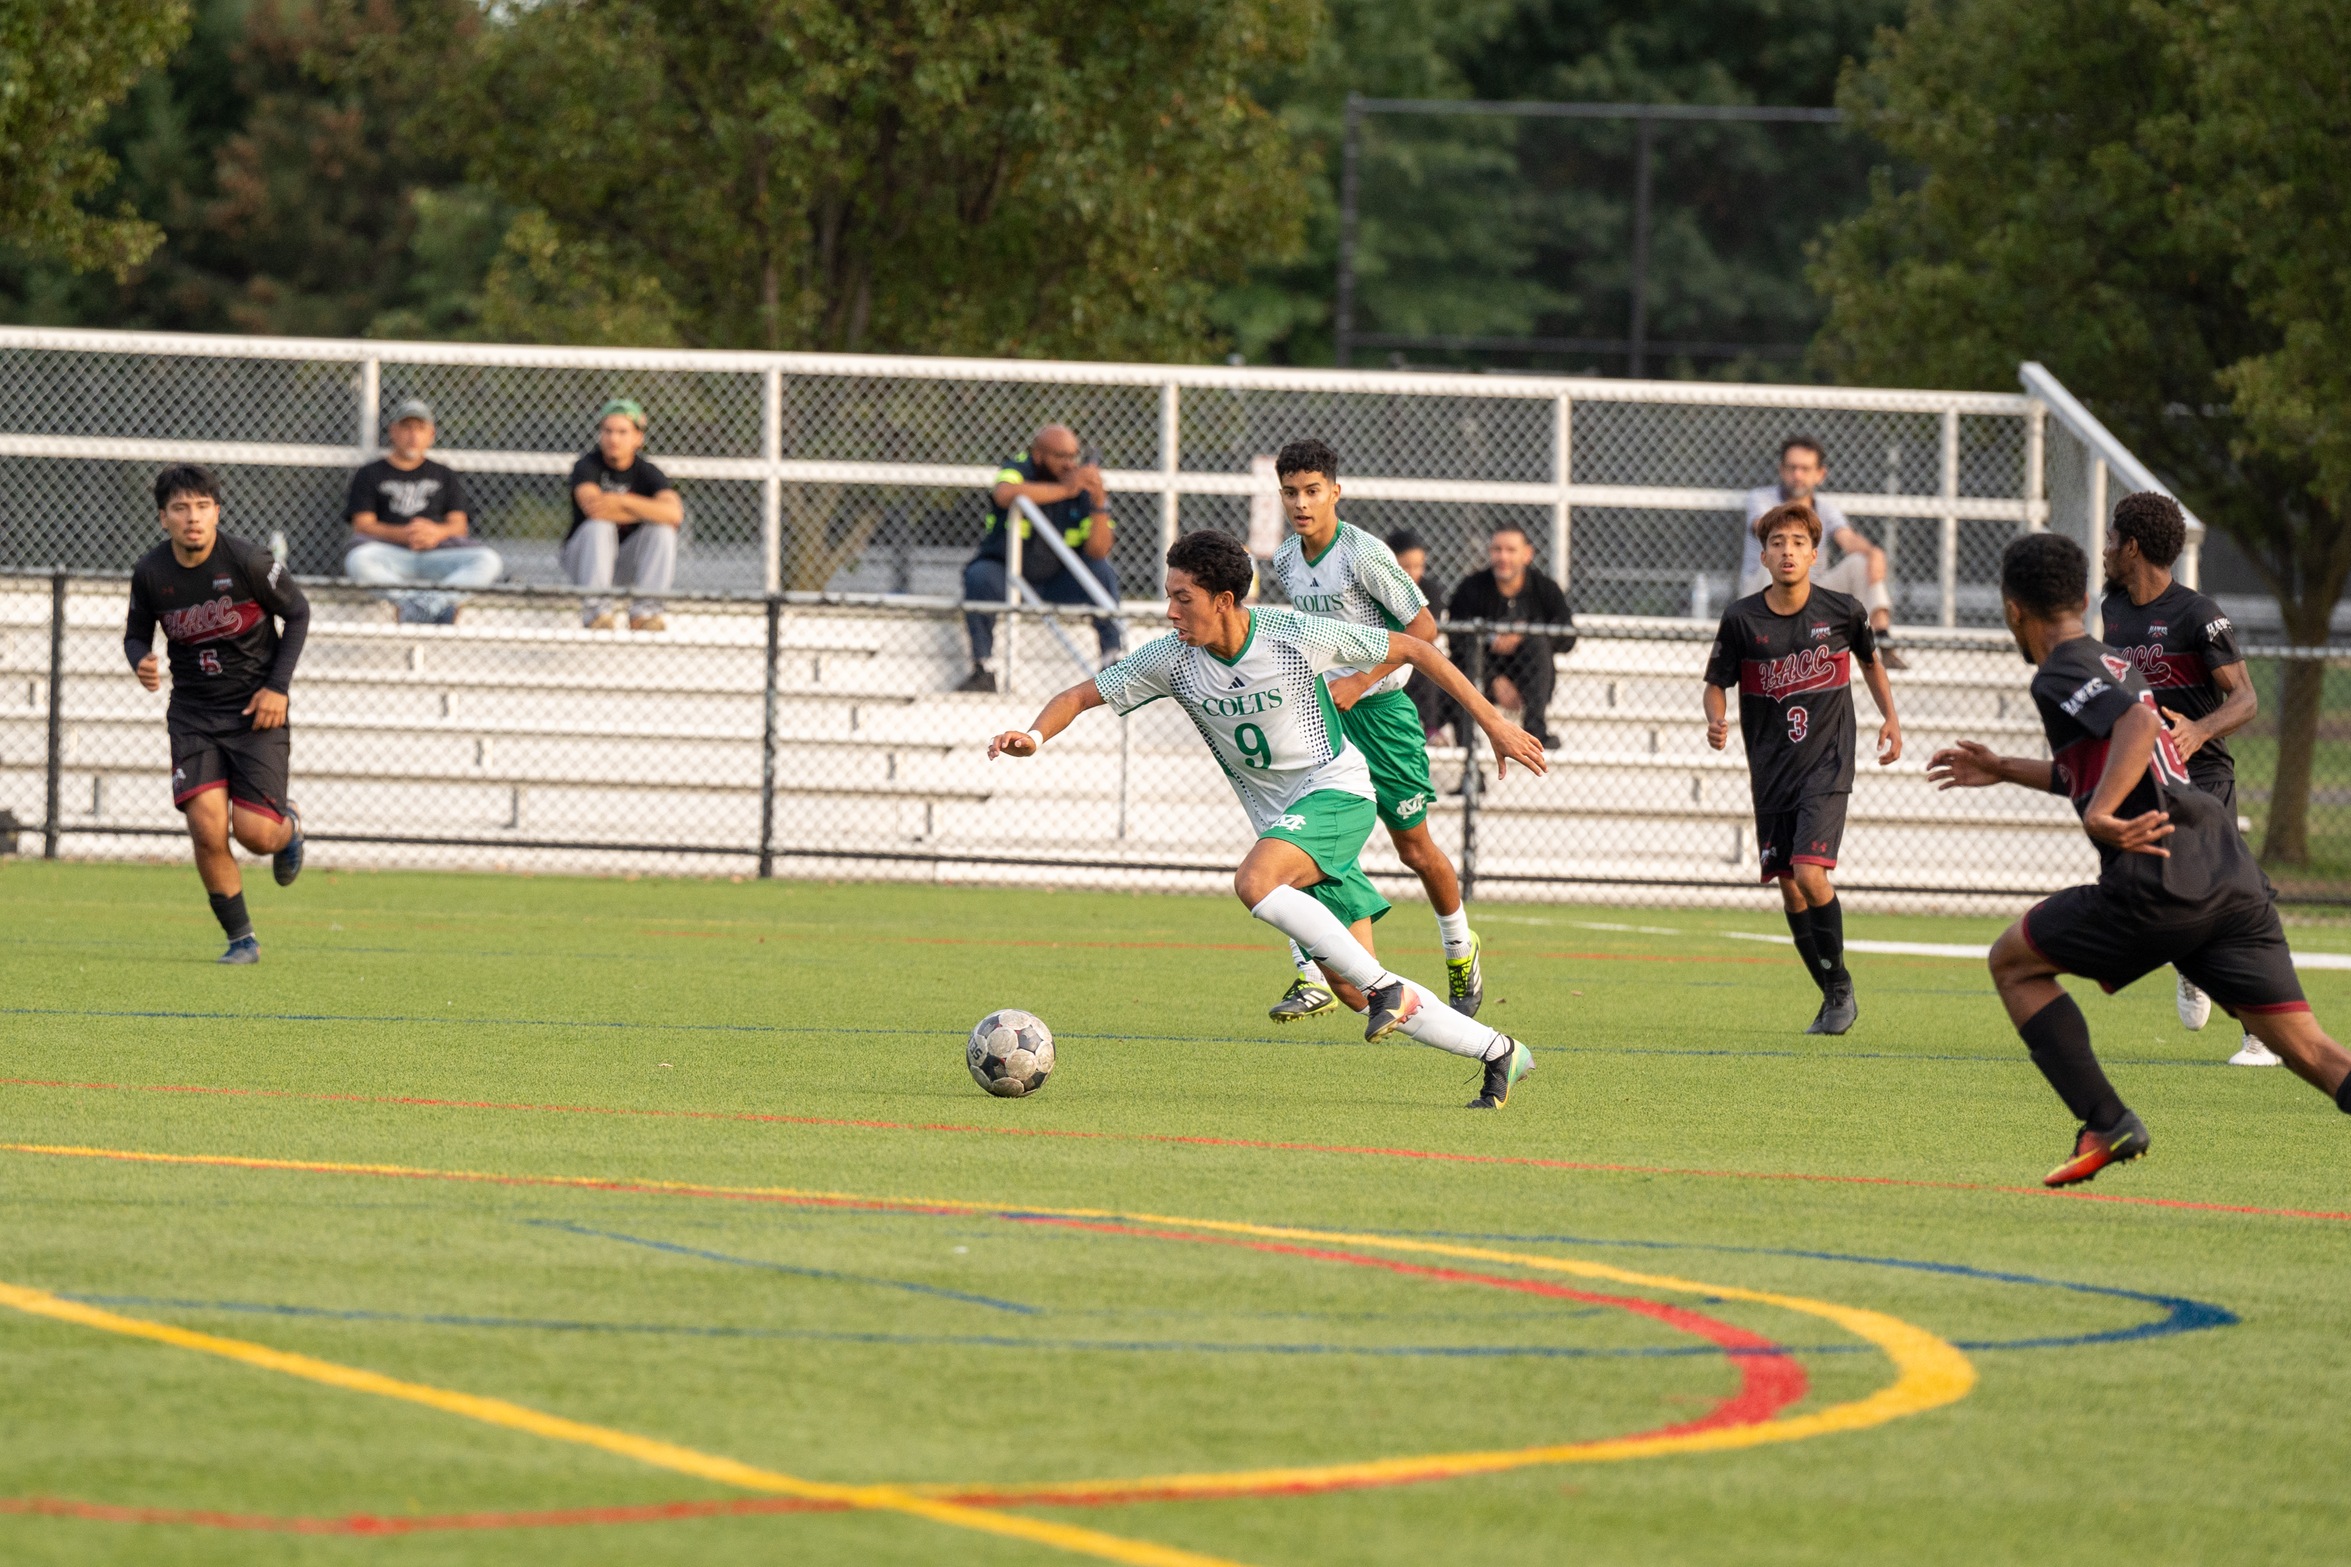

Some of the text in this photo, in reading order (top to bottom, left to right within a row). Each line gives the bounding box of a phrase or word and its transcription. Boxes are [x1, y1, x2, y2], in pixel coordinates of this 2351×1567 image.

[1295, 594, 1345, 612] COLTS
[200, 649, 223, 676] 5
[1759, 645, 1834, 691] HACC
[1202, 688, 1283, 717] COLTS
[1787, 706, 1808, 743] 3
[1234, 722, 1272, 770] 9
